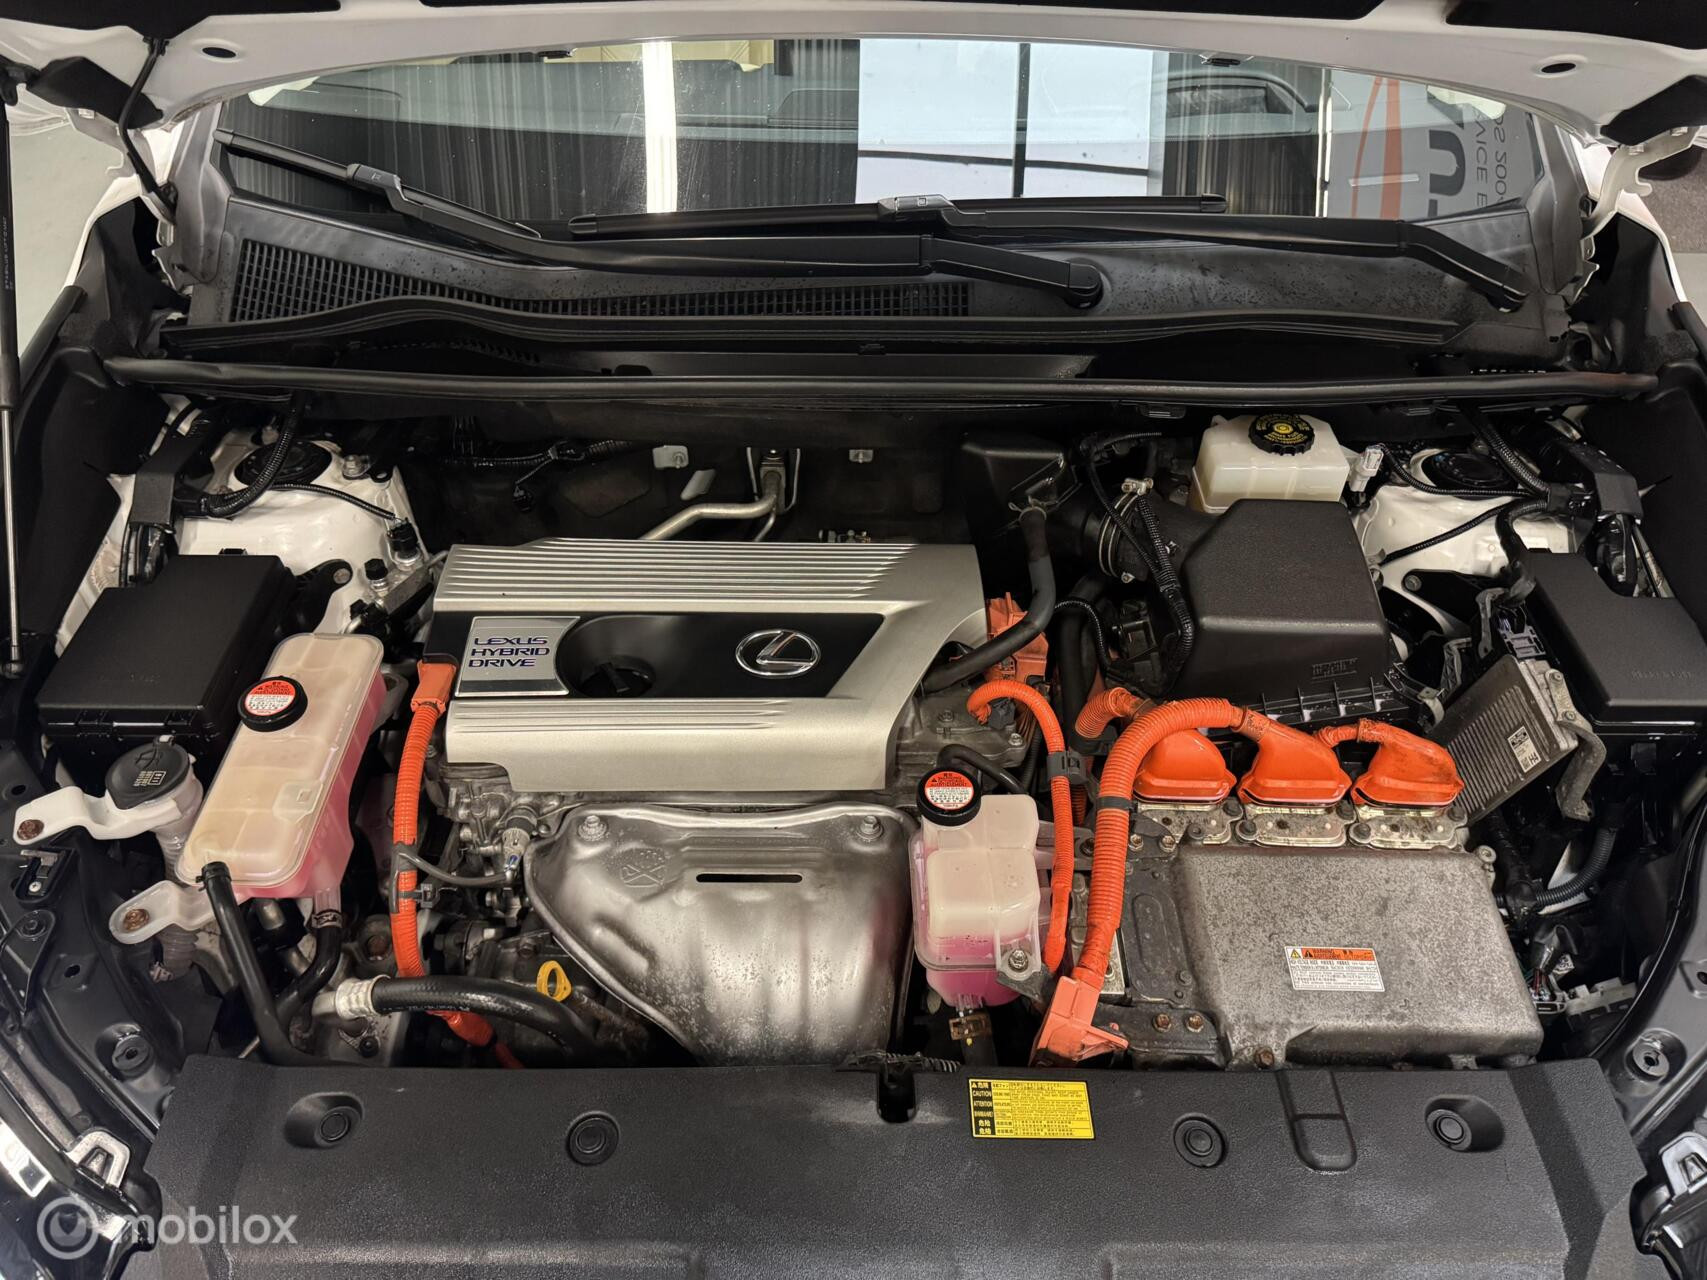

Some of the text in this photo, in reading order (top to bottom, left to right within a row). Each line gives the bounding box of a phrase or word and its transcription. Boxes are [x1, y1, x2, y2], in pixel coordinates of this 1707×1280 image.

[474, 636, 549, 645] LEXUS
[471, 647, 550, 656] HYBRID
[468, 659, 536, 667] DRIVE
